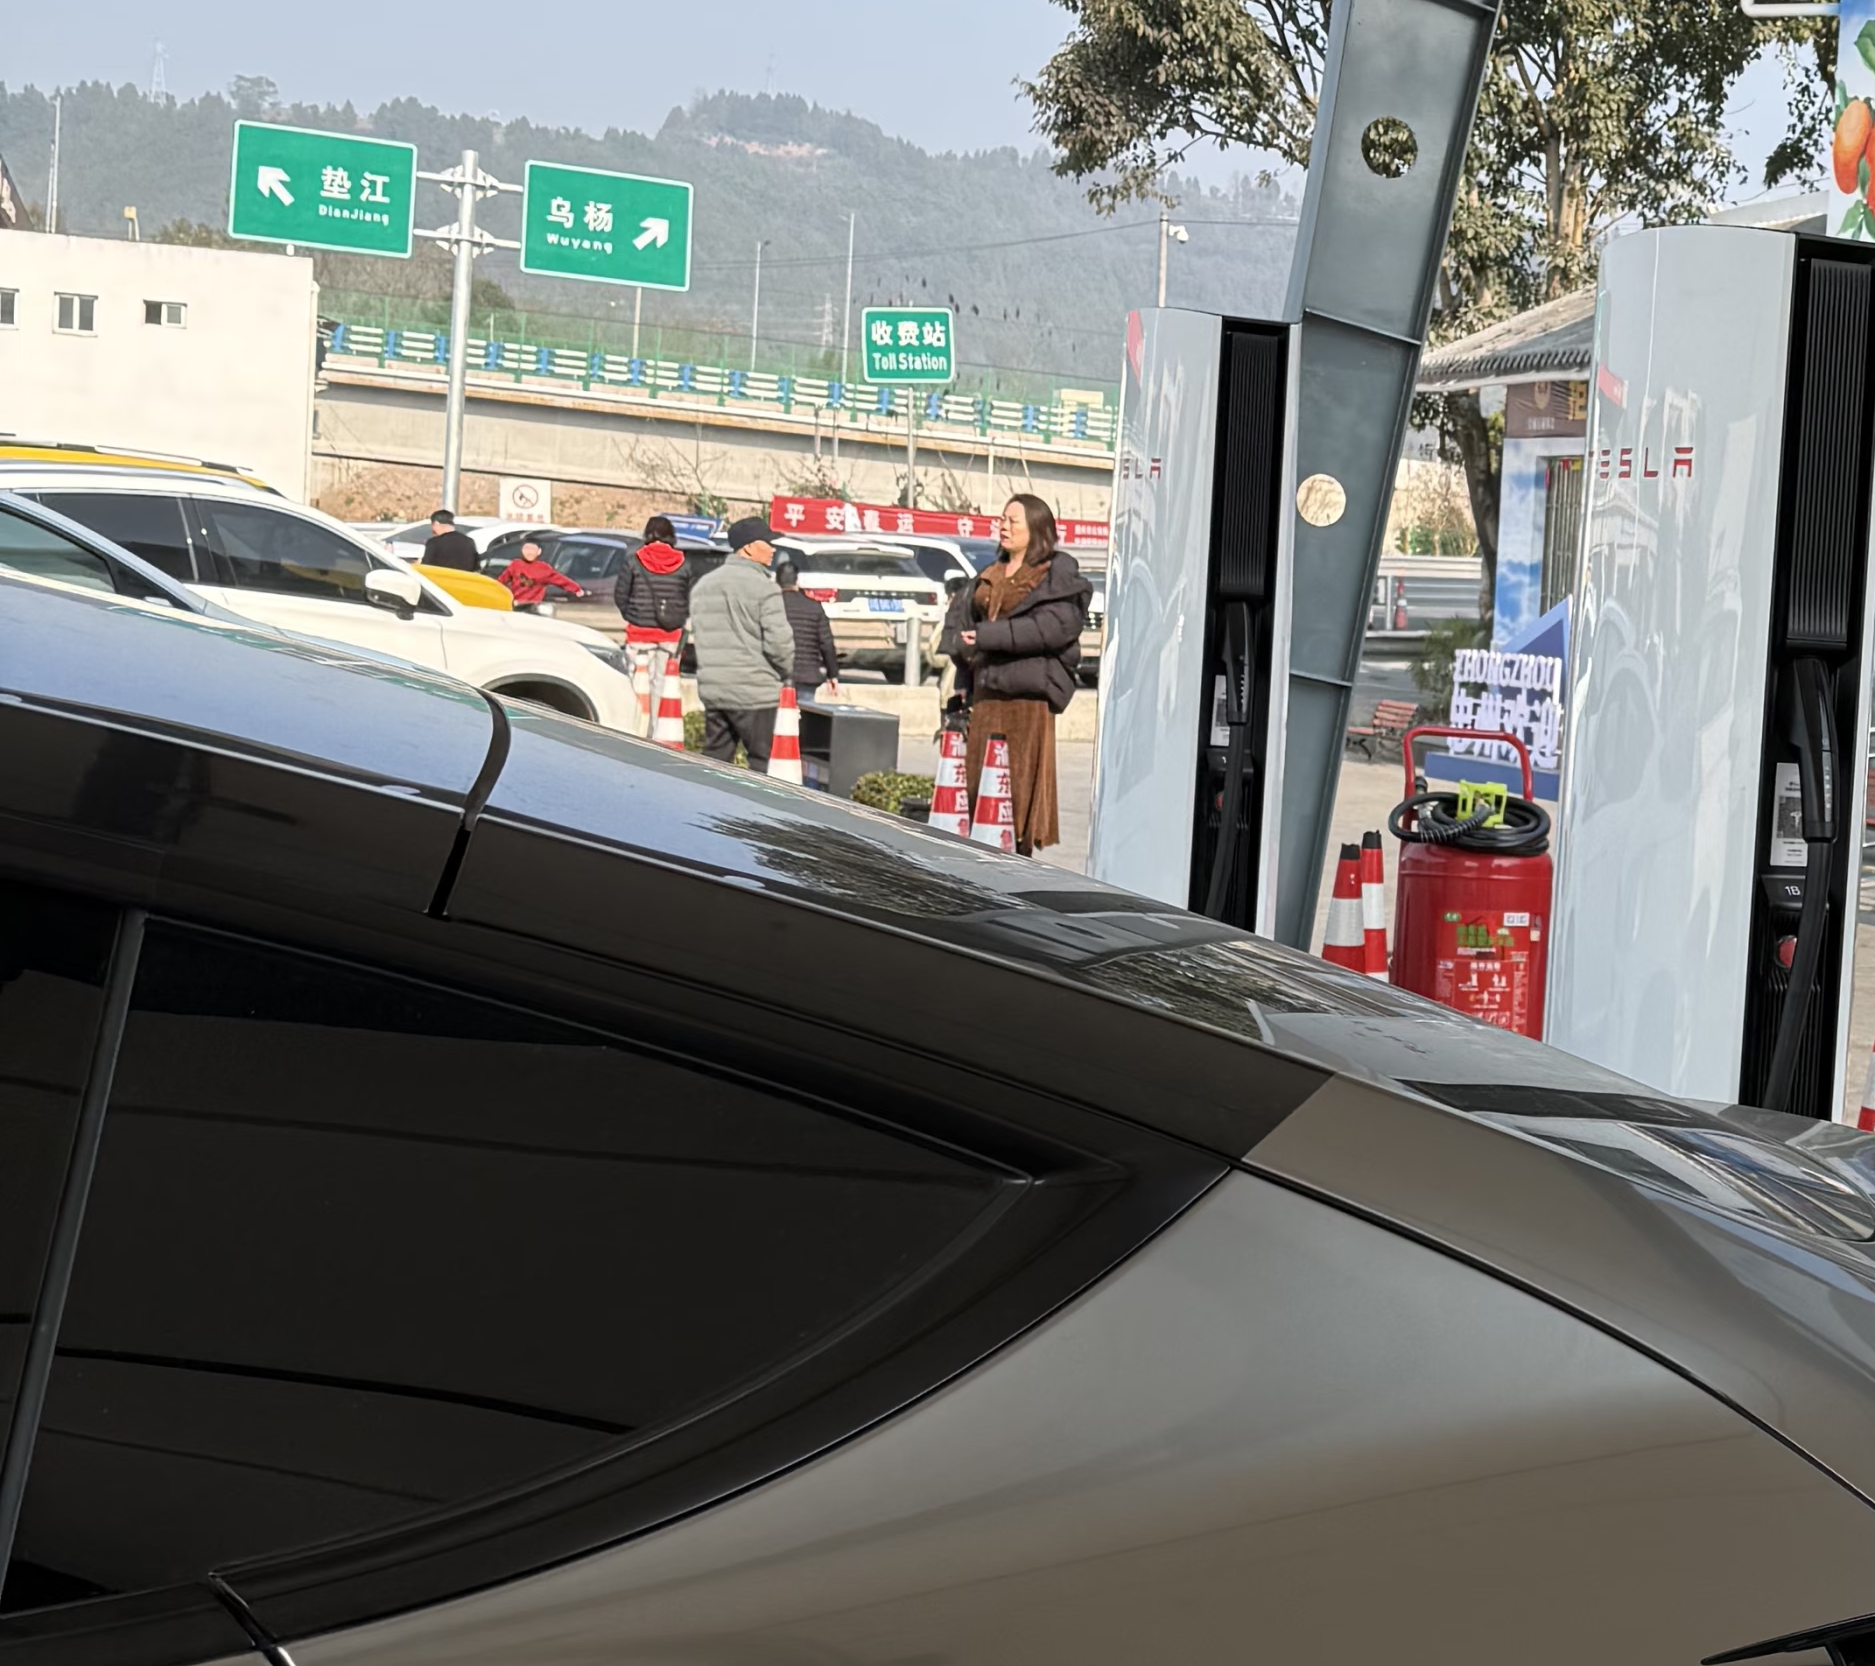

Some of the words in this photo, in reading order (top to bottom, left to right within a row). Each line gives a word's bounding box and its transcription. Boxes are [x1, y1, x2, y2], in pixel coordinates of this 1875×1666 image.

[319, 165, 391, 205] 垫江
[545, 195, 614, 234] 乌杨
[546, 232, 614, 255] Wuyang
[871, 320, 947, 347] 收费站
[872, 352, 898, 371] Toll
[898, 352, 948, 371] Station
[1588, 446, 1694, 479] ESLA
[1784, 885, 1802, 897] 1B
